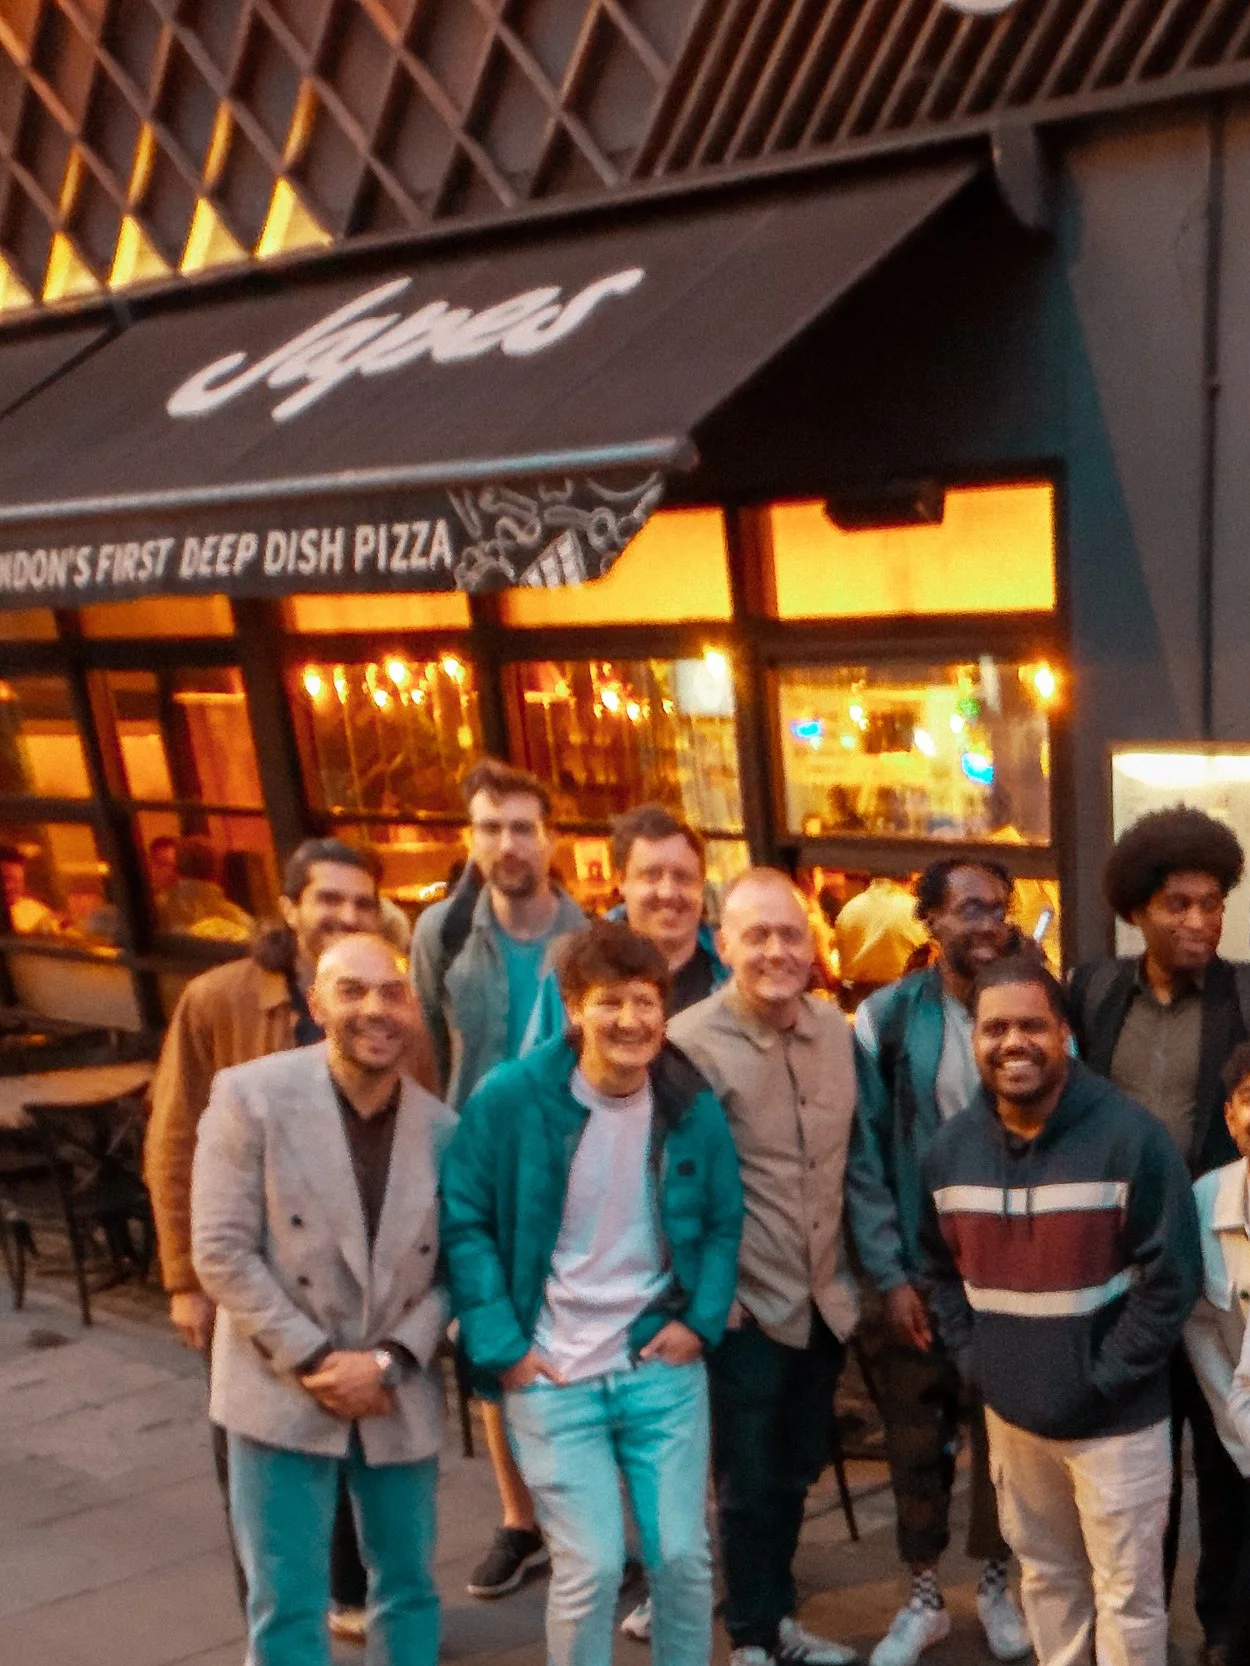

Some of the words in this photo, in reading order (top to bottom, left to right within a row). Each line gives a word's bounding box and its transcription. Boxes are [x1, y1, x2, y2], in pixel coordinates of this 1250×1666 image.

[167, 267, 645, 422] Japes
[96, 538, 174, 583] FIRST
[181, 531, 257, 579] DEEP
[263, 526, 345, 575] DISH
[355, 518, 452, 572] PIZZA
